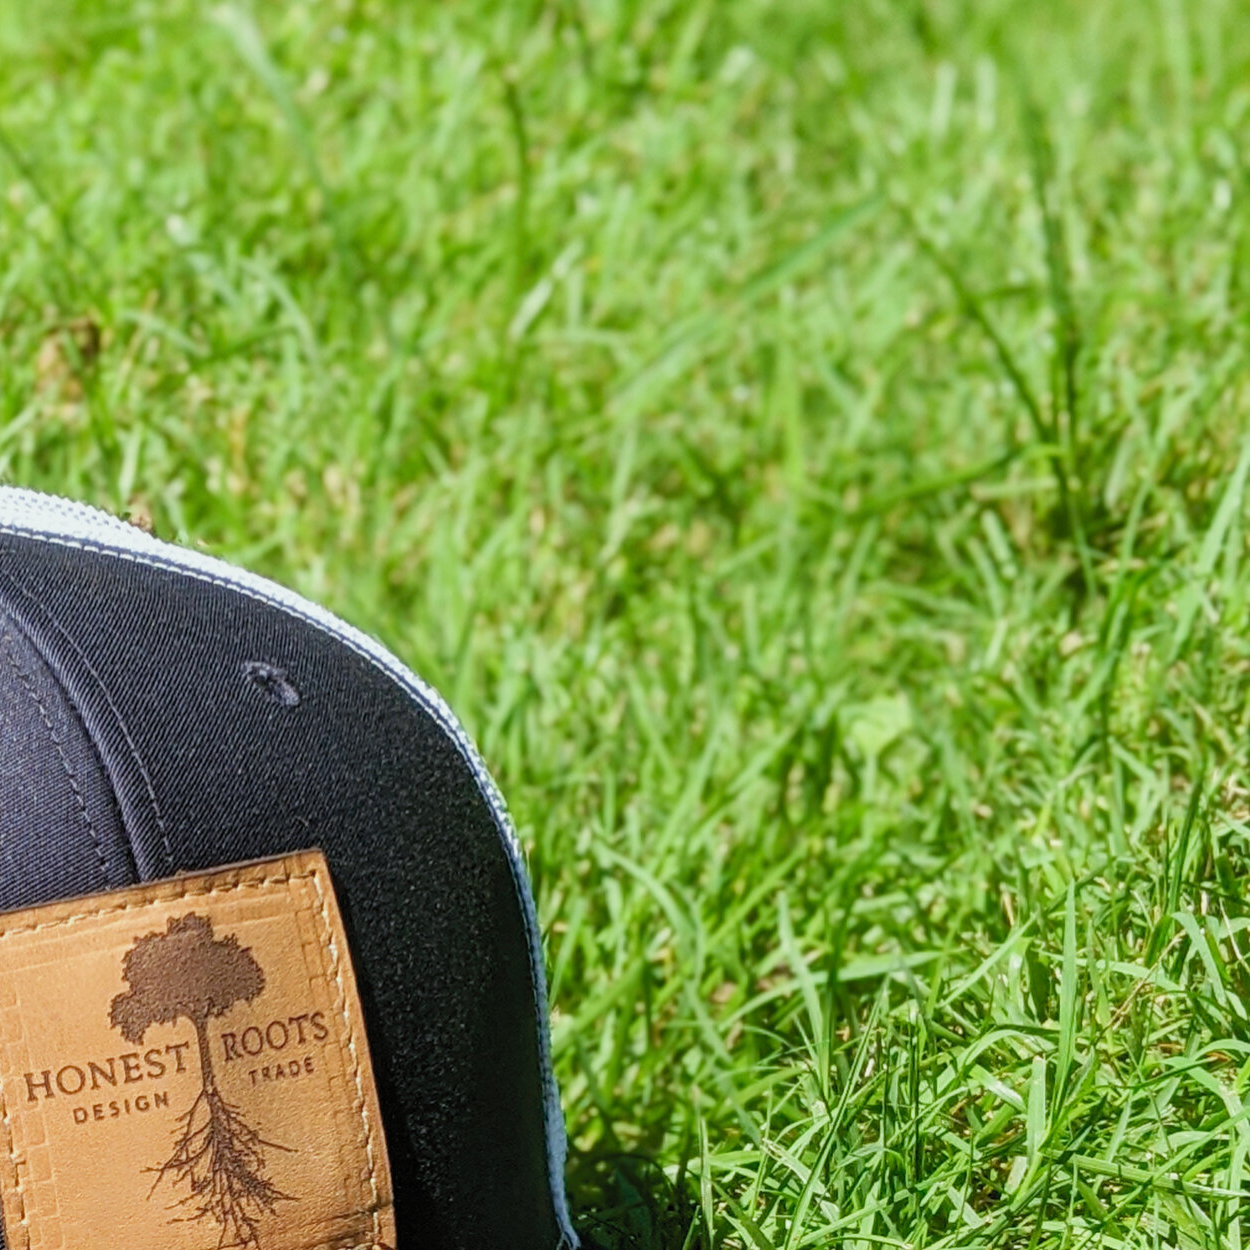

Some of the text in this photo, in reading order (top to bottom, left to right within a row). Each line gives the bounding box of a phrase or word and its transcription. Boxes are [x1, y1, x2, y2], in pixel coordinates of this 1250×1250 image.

[23, 1012, 329, 1102] HONEST ROOTS
[73, 1057, 315, 1125] DESIGN TRADE
